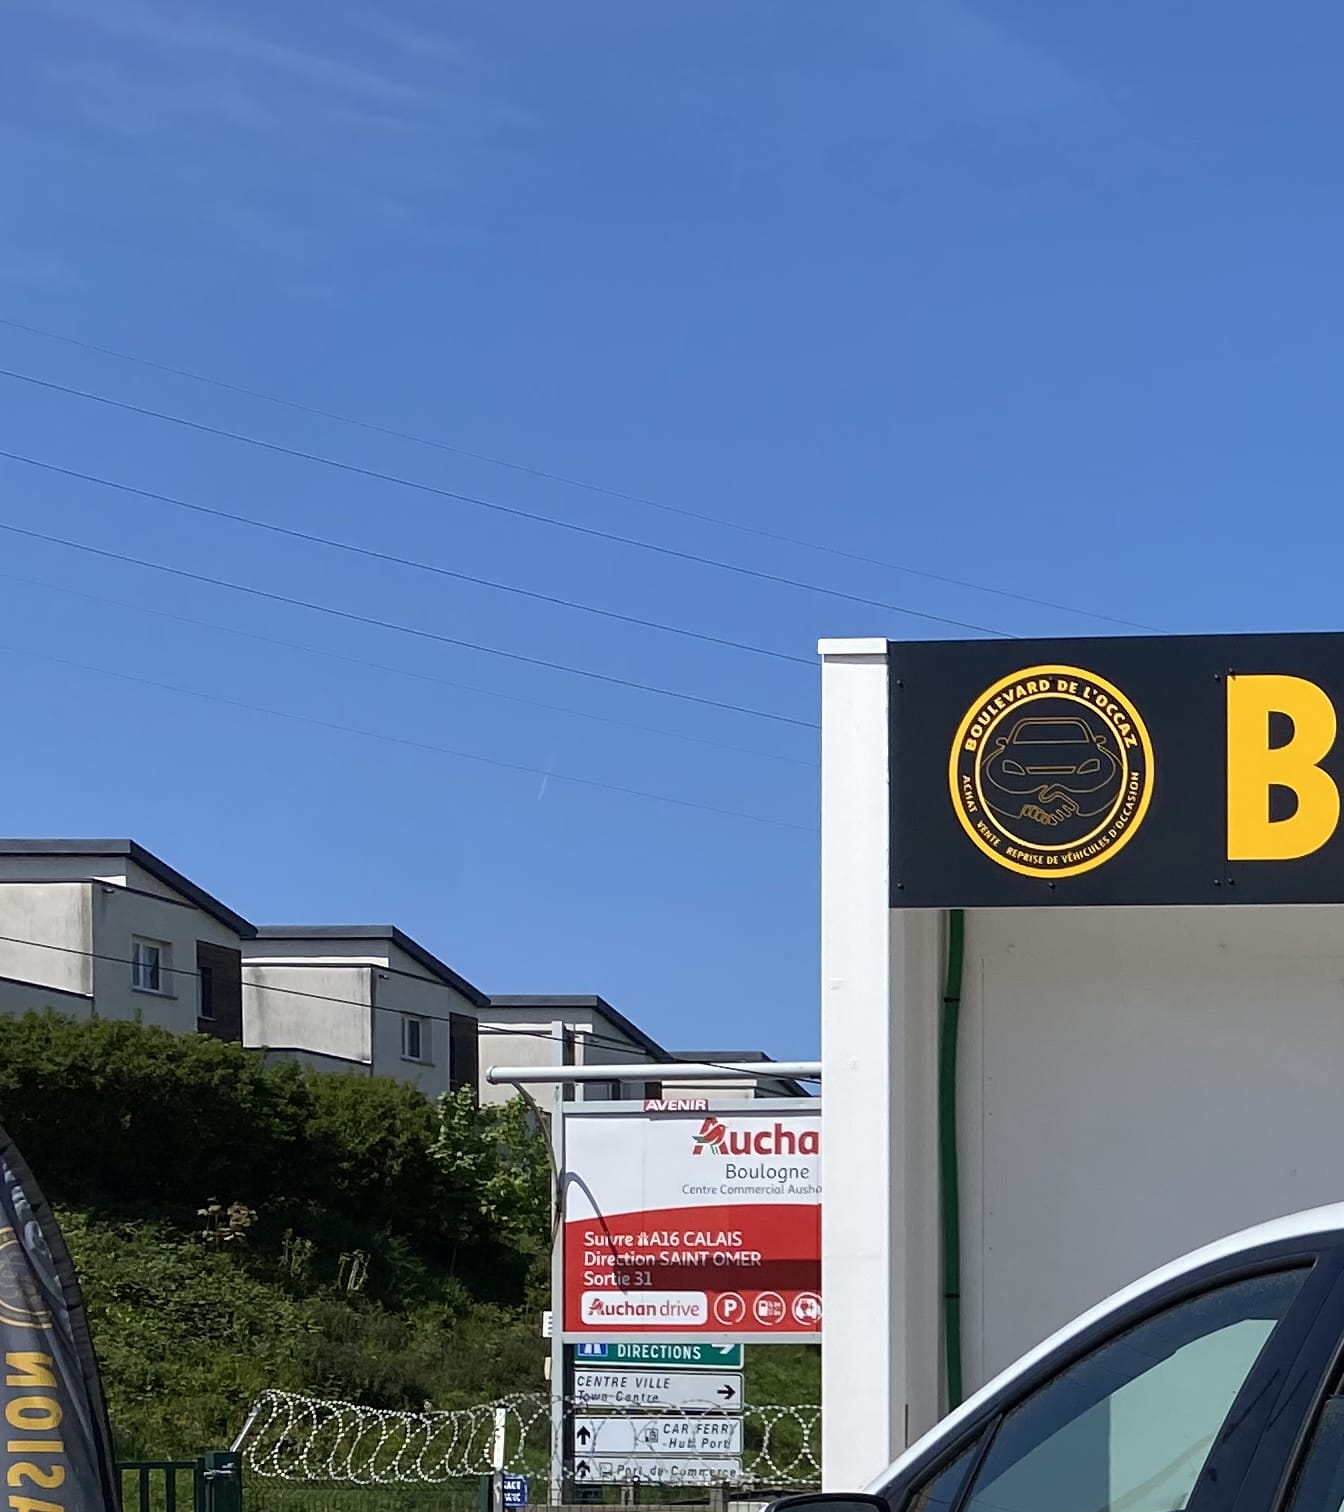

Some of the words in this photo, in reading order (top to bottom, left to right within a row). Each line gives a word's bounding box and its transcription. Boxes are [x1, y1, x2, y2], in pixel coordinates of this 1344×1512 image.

[964, 679, 1050, 752] BOULEVARD
[1057, 680, 1079, 694] DE
[1083, 686, 1138, 749] L'OCCAZ
[962, 774, 978, 814] ACHAT
[976, 820, 1001, 848] VENTE
[1005, 846, 1044, 865] REPRISE
[1046, 855, 1059, 865] DE
[1109, 771, 1140, 839] D'OCCASION
[645, 1099, 708, 1111] AVENIR
[692, 1116, 820, 1155] Aucha
[725, 1163, 810, 1184] Boulogne
[682, 1184, 717, 1195] Centre
[720, 1184, 785, 1195] Commercial
[584, 1231, 633, 1247] Suivre
[650, 1231, 680, 1247] A16
[683, 1231, 742, 1247] CALAIS
[584, 1250, 655, 1267] Direction
[660, 1251, 709, 1266] SAINT
[712, 1252, 762, 1267] OMER
[584, 1270, 630, 1286] Sortie
[634, 1270, 652, 1286] 31
[588, 1298, 657, 1316] Auchan
[659, 1300, 700, 1317] drive
[617, 1344, 702, 1360] DIRECTIONS
[577, 1375, 628, 1388] CENTRE
[635, 1377, 671, 1389] VILLE
[615, 1390, 659, 1402] Centre
[663, 1423, 689, 1435] CAR
[695, 1424, 737, 1436] FERRY
